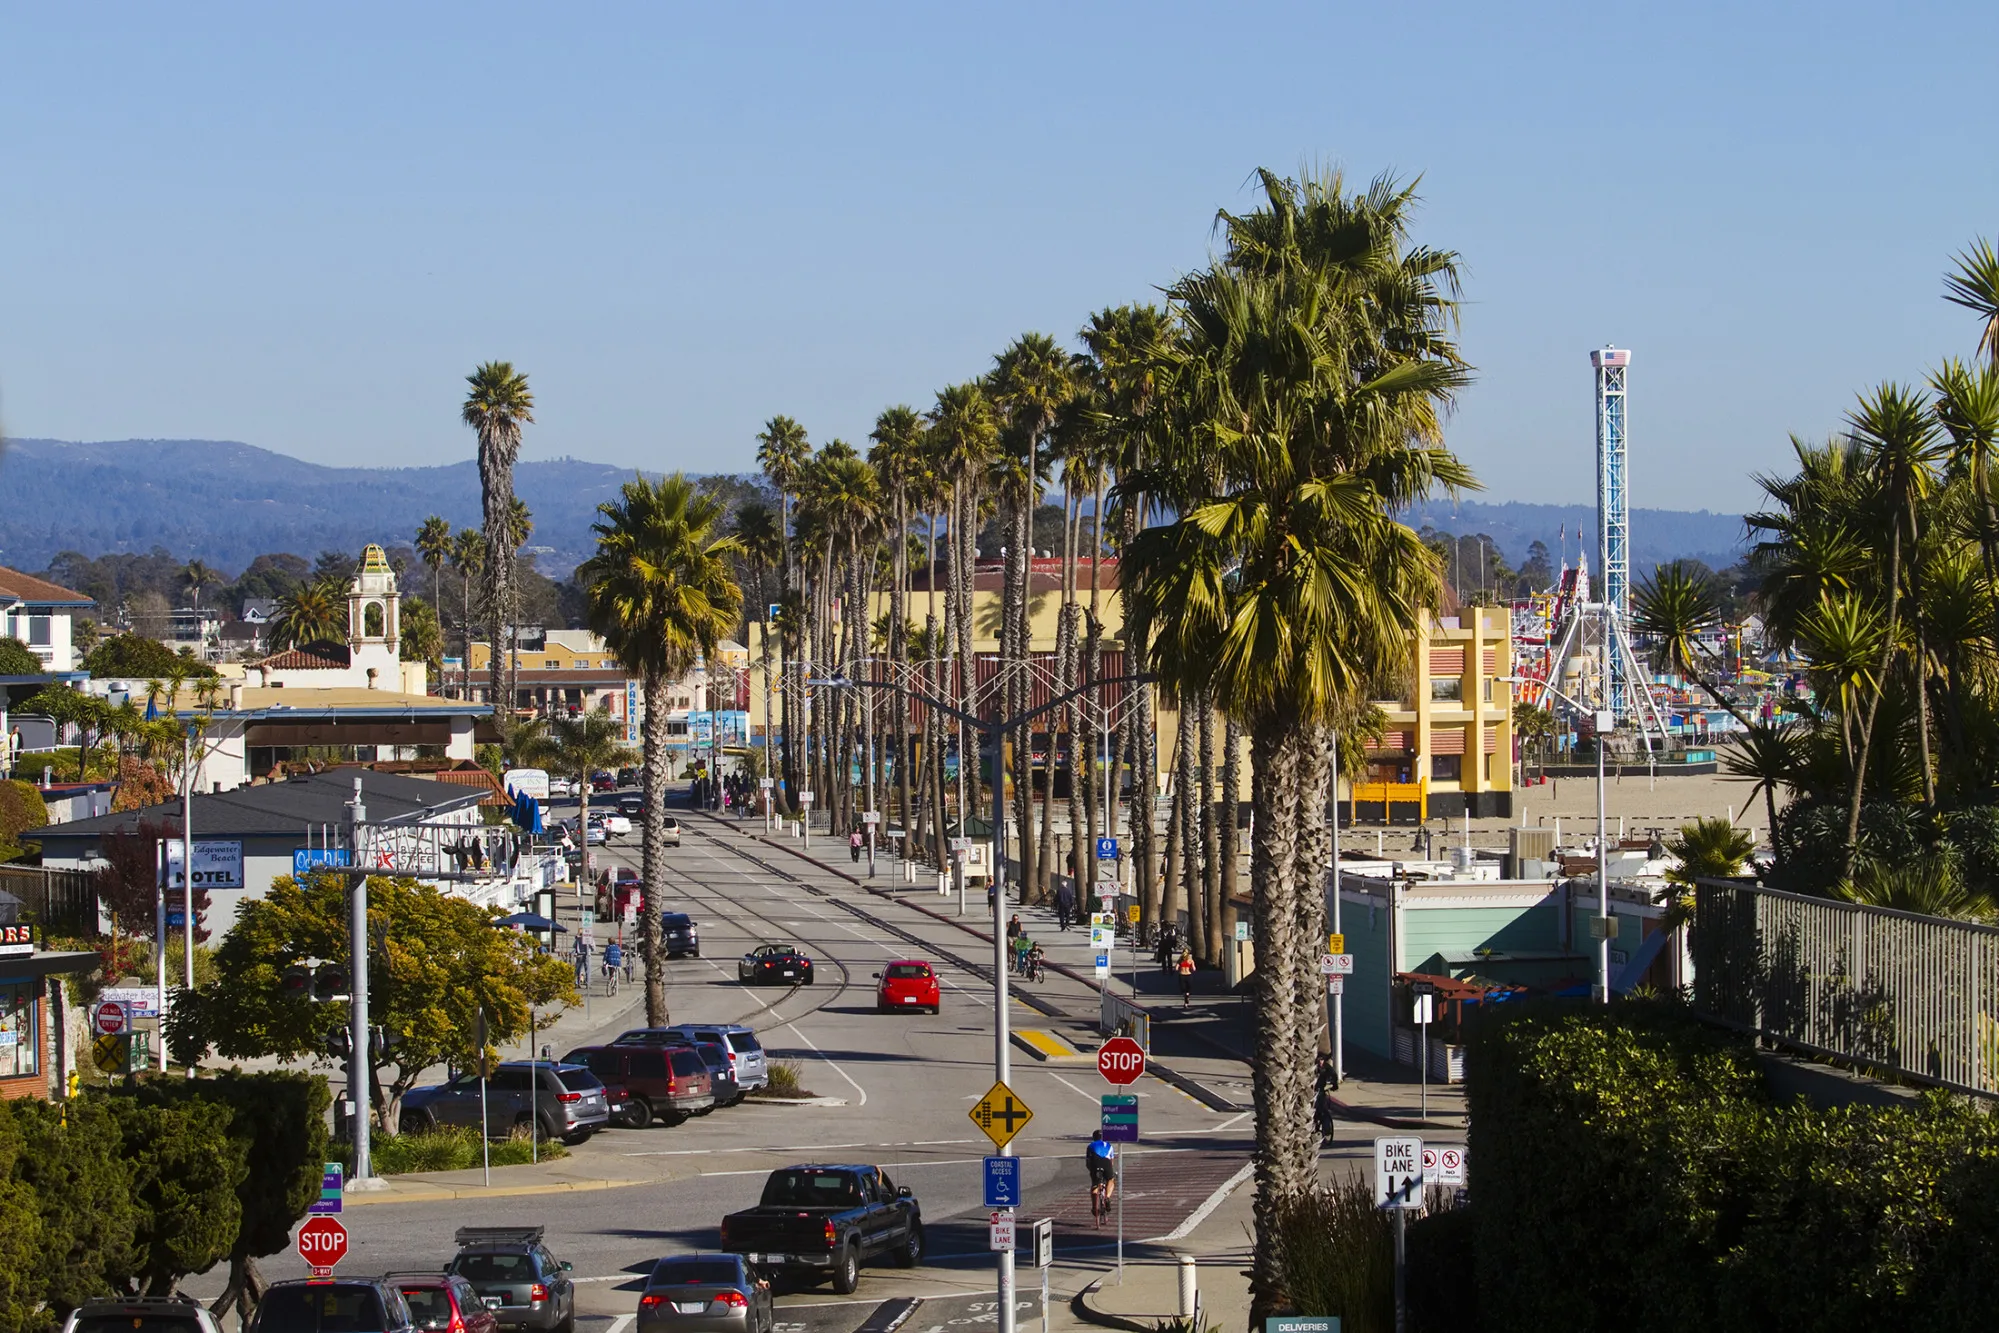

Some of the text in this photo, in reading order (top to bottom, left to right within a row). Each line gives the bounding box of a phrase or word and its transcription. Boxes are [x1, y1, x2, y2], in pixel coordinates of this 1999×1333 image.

[193, 845, 237, 855] Edgewater
[0, 926, 30, 943] RS
[1101, 1052, 1142, 1070] STOP
[1386, 1145, 1412, 1157] BIKE
[1384, 1160, 1414, 1172] LANE
[301, 1233, 345, 1251] STOP
[1278, 1323, 1328, 1332] DELIVERIES
